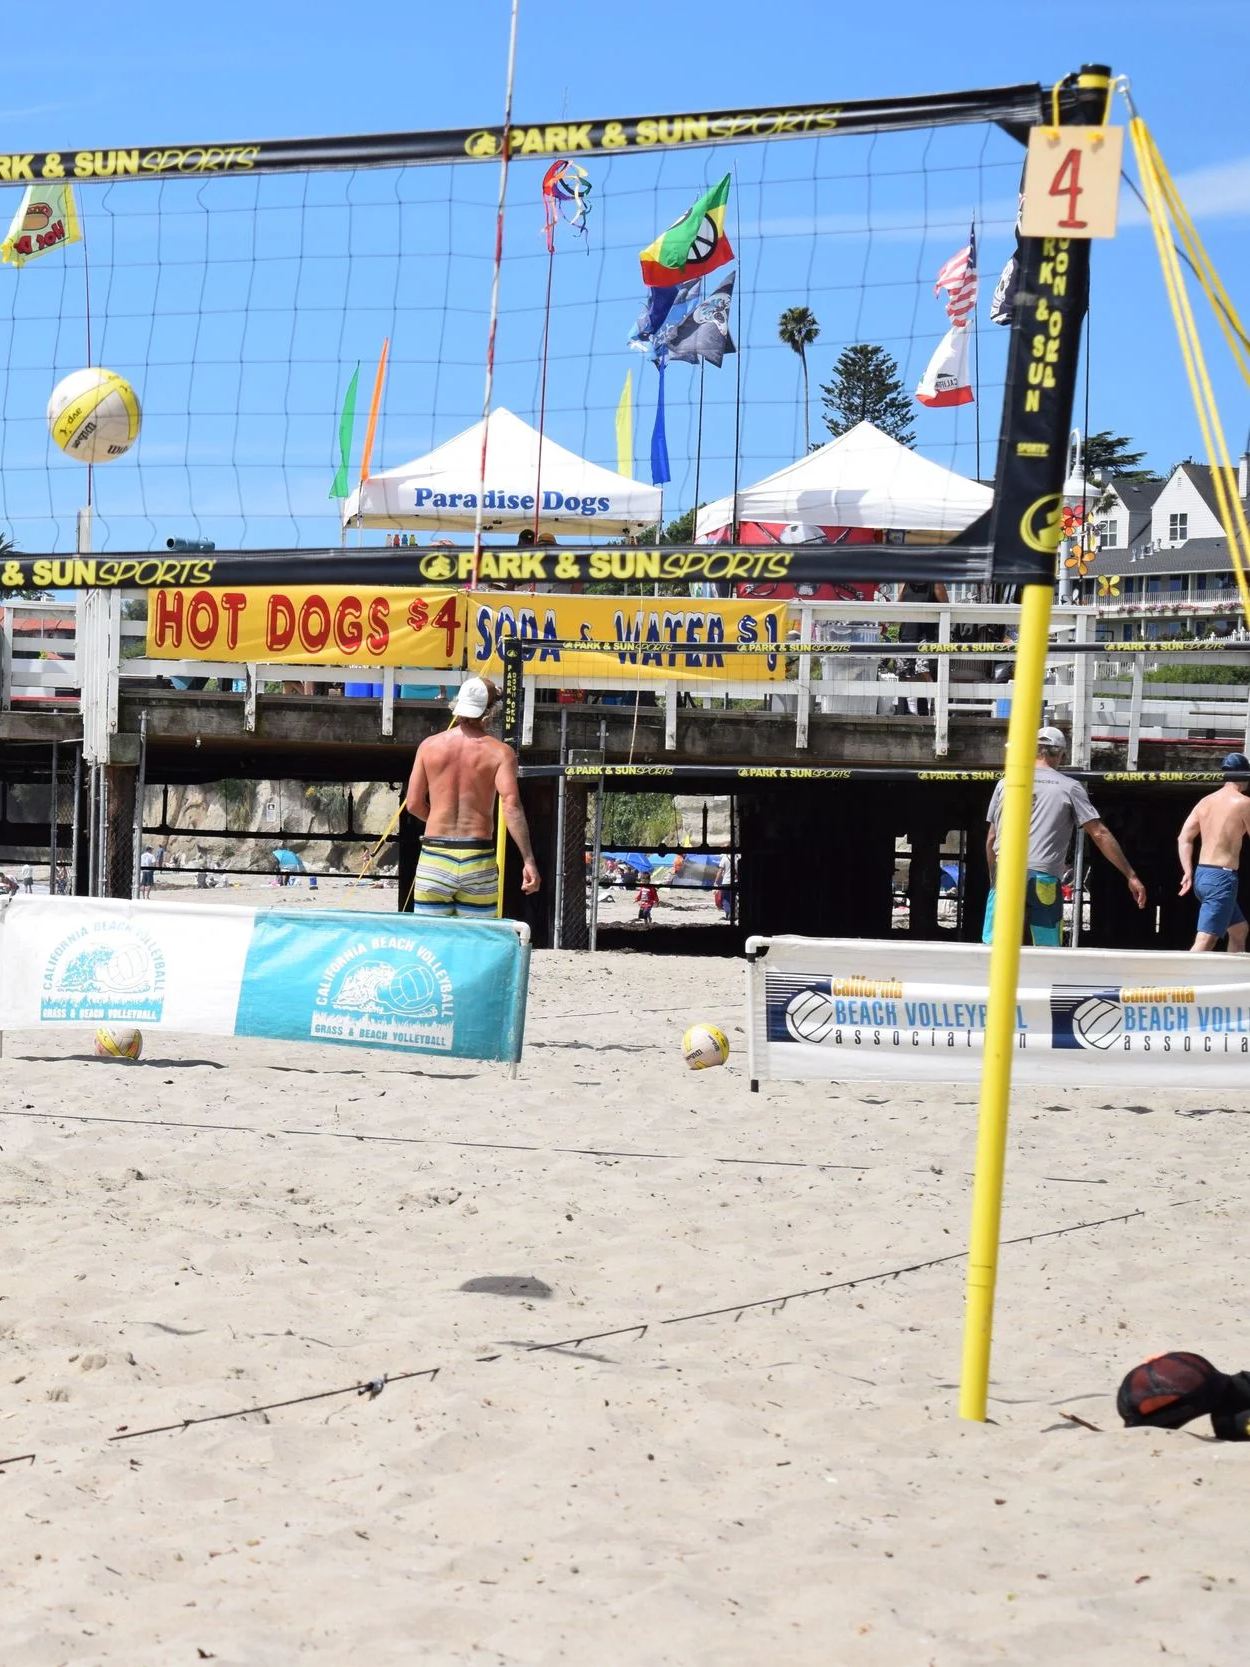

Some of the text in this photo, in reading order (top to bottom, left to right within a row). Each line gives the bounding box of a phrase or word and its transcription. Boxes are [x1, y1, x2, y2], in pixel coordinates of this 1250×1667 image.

[509, 107, 842, 154] PARK & SUN SPORTS
[42, 152, 66, 179] &
[74, 149, 140, 178] SUN
[140, 146, 261, 174] SPORTS
[1049, 149, 1088, 229] 4
[414, 488, 611, 516] Paradise Dogs
[1, 560, 25, 587] &
[32, 559, 97, 586] SUN
[96, 559, 216, 585] SPORTS
[458, 551, 795, 580] PARK & SUN SPORTS
[154, 589, 461, 658] HOT DOGS $4
[475, 603, 561, 663] SODA
[613, 609, 725, 668] WATER
[43, 926, 89, 991] CALIFORNIA
[315, 936, 454, 1018] CALIFORNIA BEACH VOLLEYBALL
[835, 1000, 898, 1026] BEACH
[1124, 1006, 1189, 1032] BEACH
[315, 1024, 343, 1036] GRASS
[359, 1028, 388, 1041] BEACH
[393, 1031, 447, 1047] VOLLEYBALL
[835, 1028, 1026, 1048] associatn
